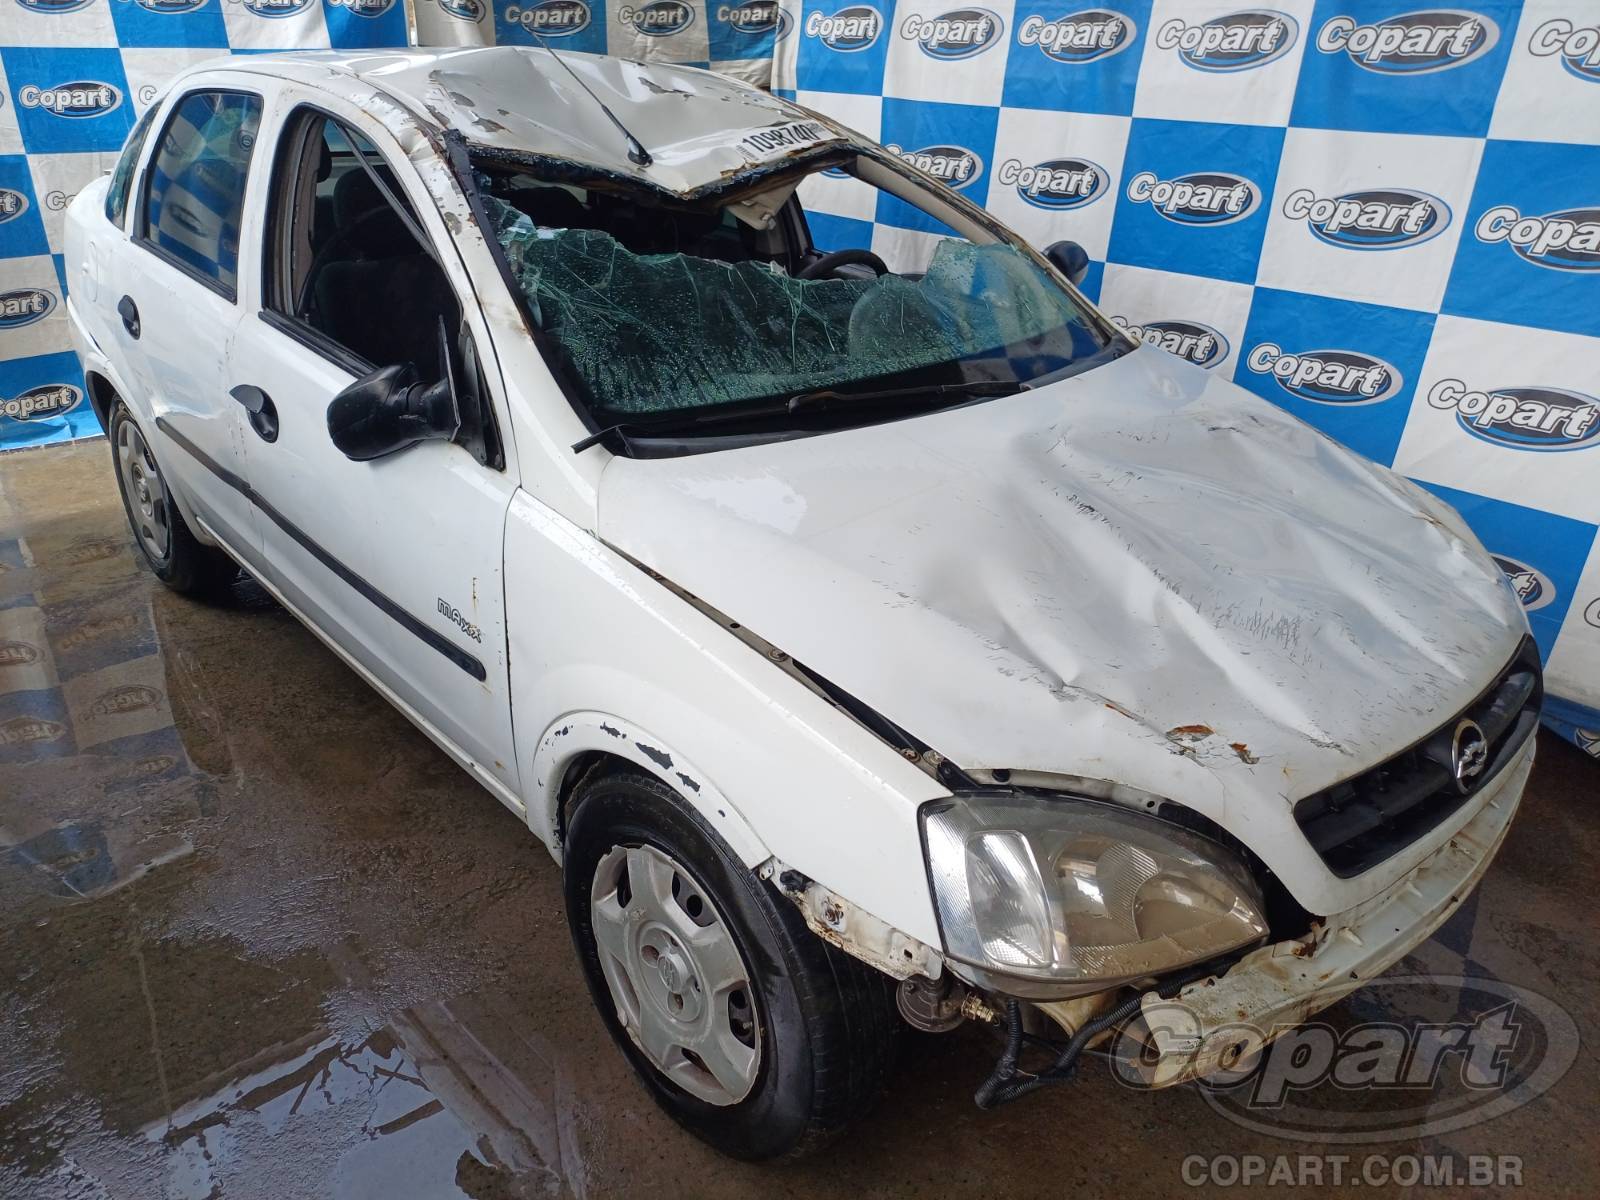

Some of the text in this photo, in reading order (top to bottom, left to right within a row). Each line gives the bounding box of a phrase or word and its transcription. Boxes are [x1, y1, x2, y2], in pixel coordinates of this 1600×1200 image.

[505, 5, 584, 28] Copart
[618, 5, 685, 28] Copart
[806, 11, 878, 47] Copart
[901, 14, 991, 49] Copart
[1018, 17, 1122, 54] Copart
[1156, 17, 1284, 58] Copart
[1317, 15, 1481, 63] Copart
[19, 85, 111, 112] Copart
[999, 158, 1098, 196] Copart
[1127, 171, 1250, 214] Copart
[1282, 189, 1431, 235] Copart
[1247, 343, 1387, 396] Copart
[1427, 378, 1598, 439] Copart
